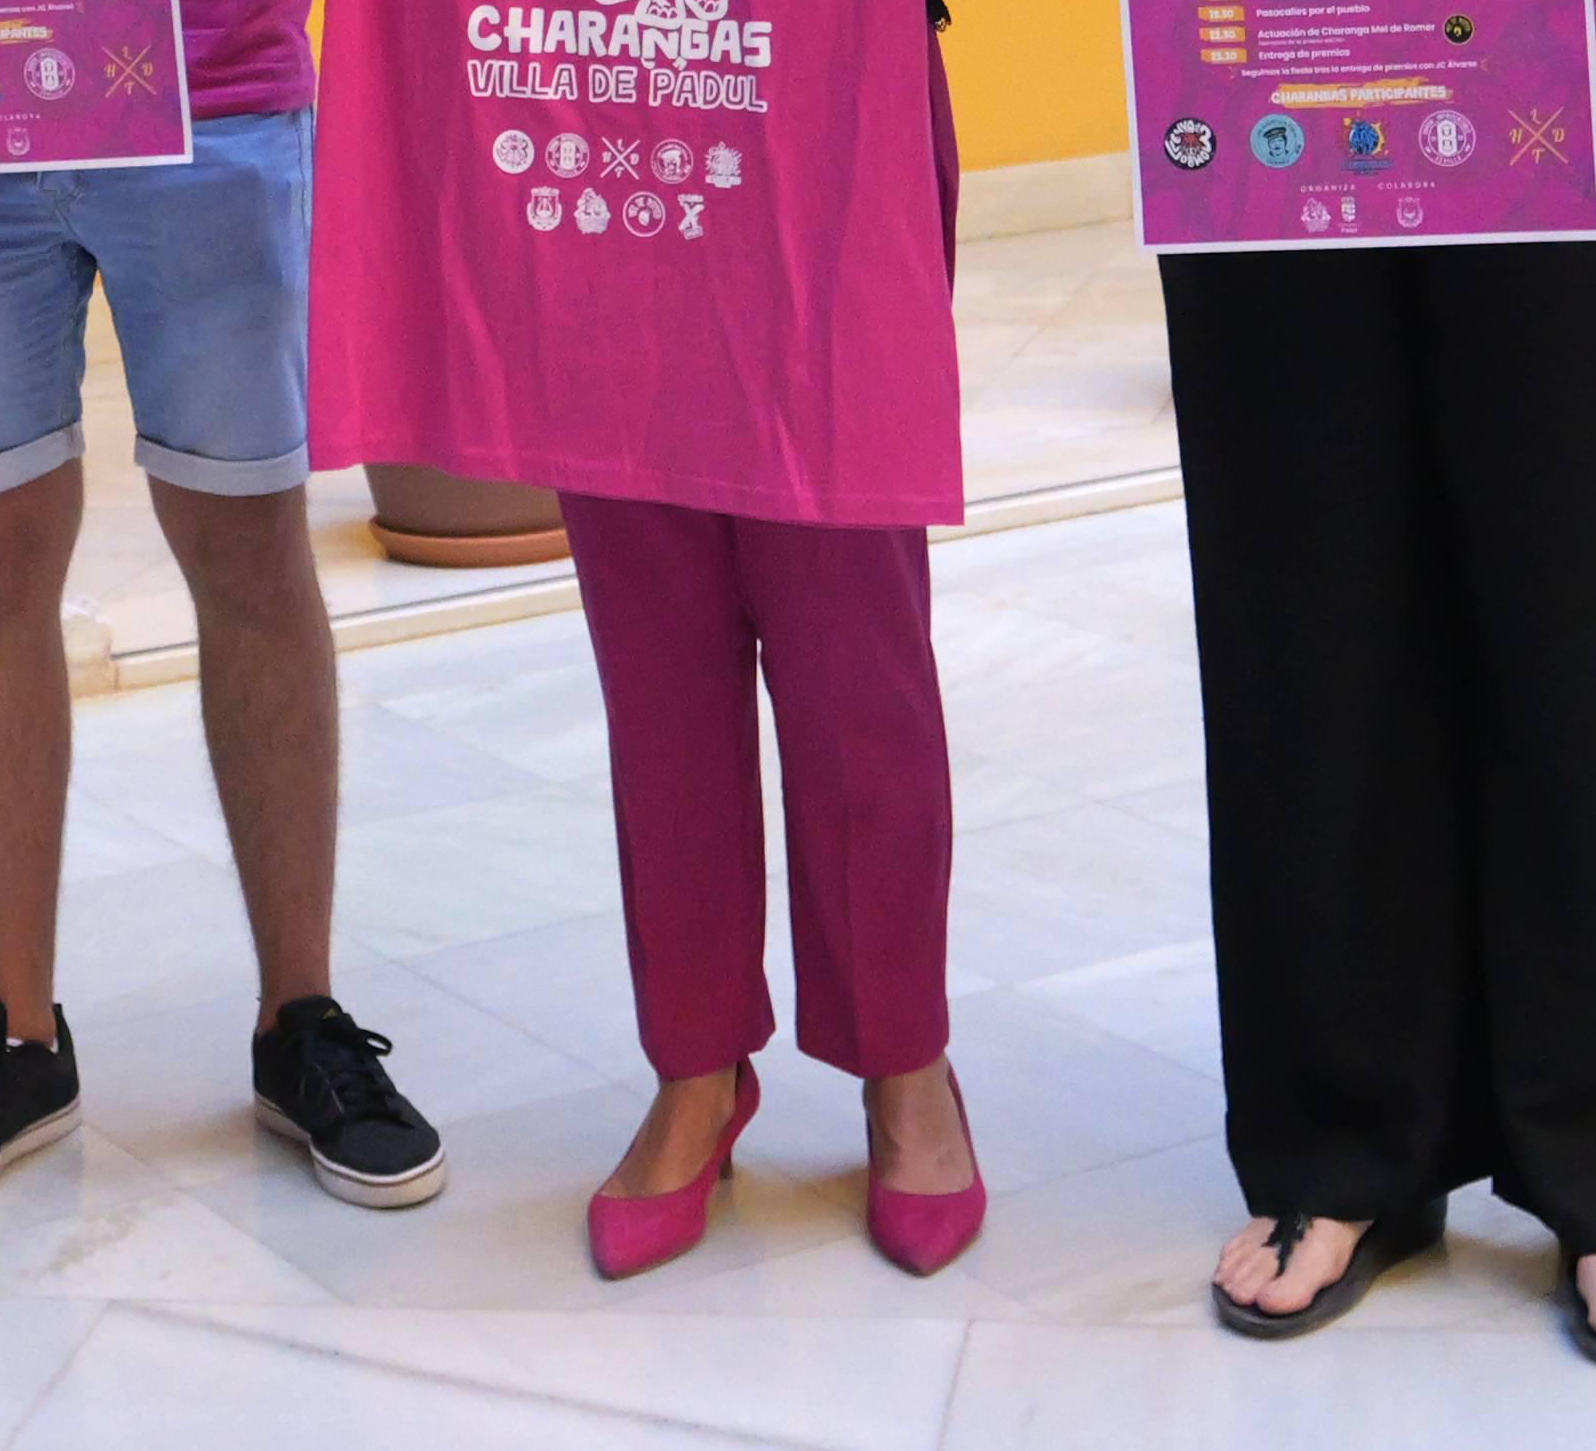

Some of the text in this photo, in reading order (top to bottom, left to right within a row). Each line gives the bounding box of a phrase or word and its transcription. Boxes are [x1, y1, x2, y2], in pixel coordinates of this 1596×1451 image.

[1256, 4, 1371, 18] Pasacalles por pueblo
[467, 4, 773, 69] CHARANGAS
[1257, 27, 1306, 39] Actuación
[1308, 27, 1320, 36] de
[1321, 25, 1369, 37] Charanga
[1389, 23, 1402, 33] de
[1259, 48, 1350, 62] Entrega de premios
[467, 59, 768, 113] VILLA DE PADUL
[1271, 85, 1447, 103] CHARANGAS PARTICIPANTES
[1300, 181, 1436, 193] ORGANIZA COLABORA
